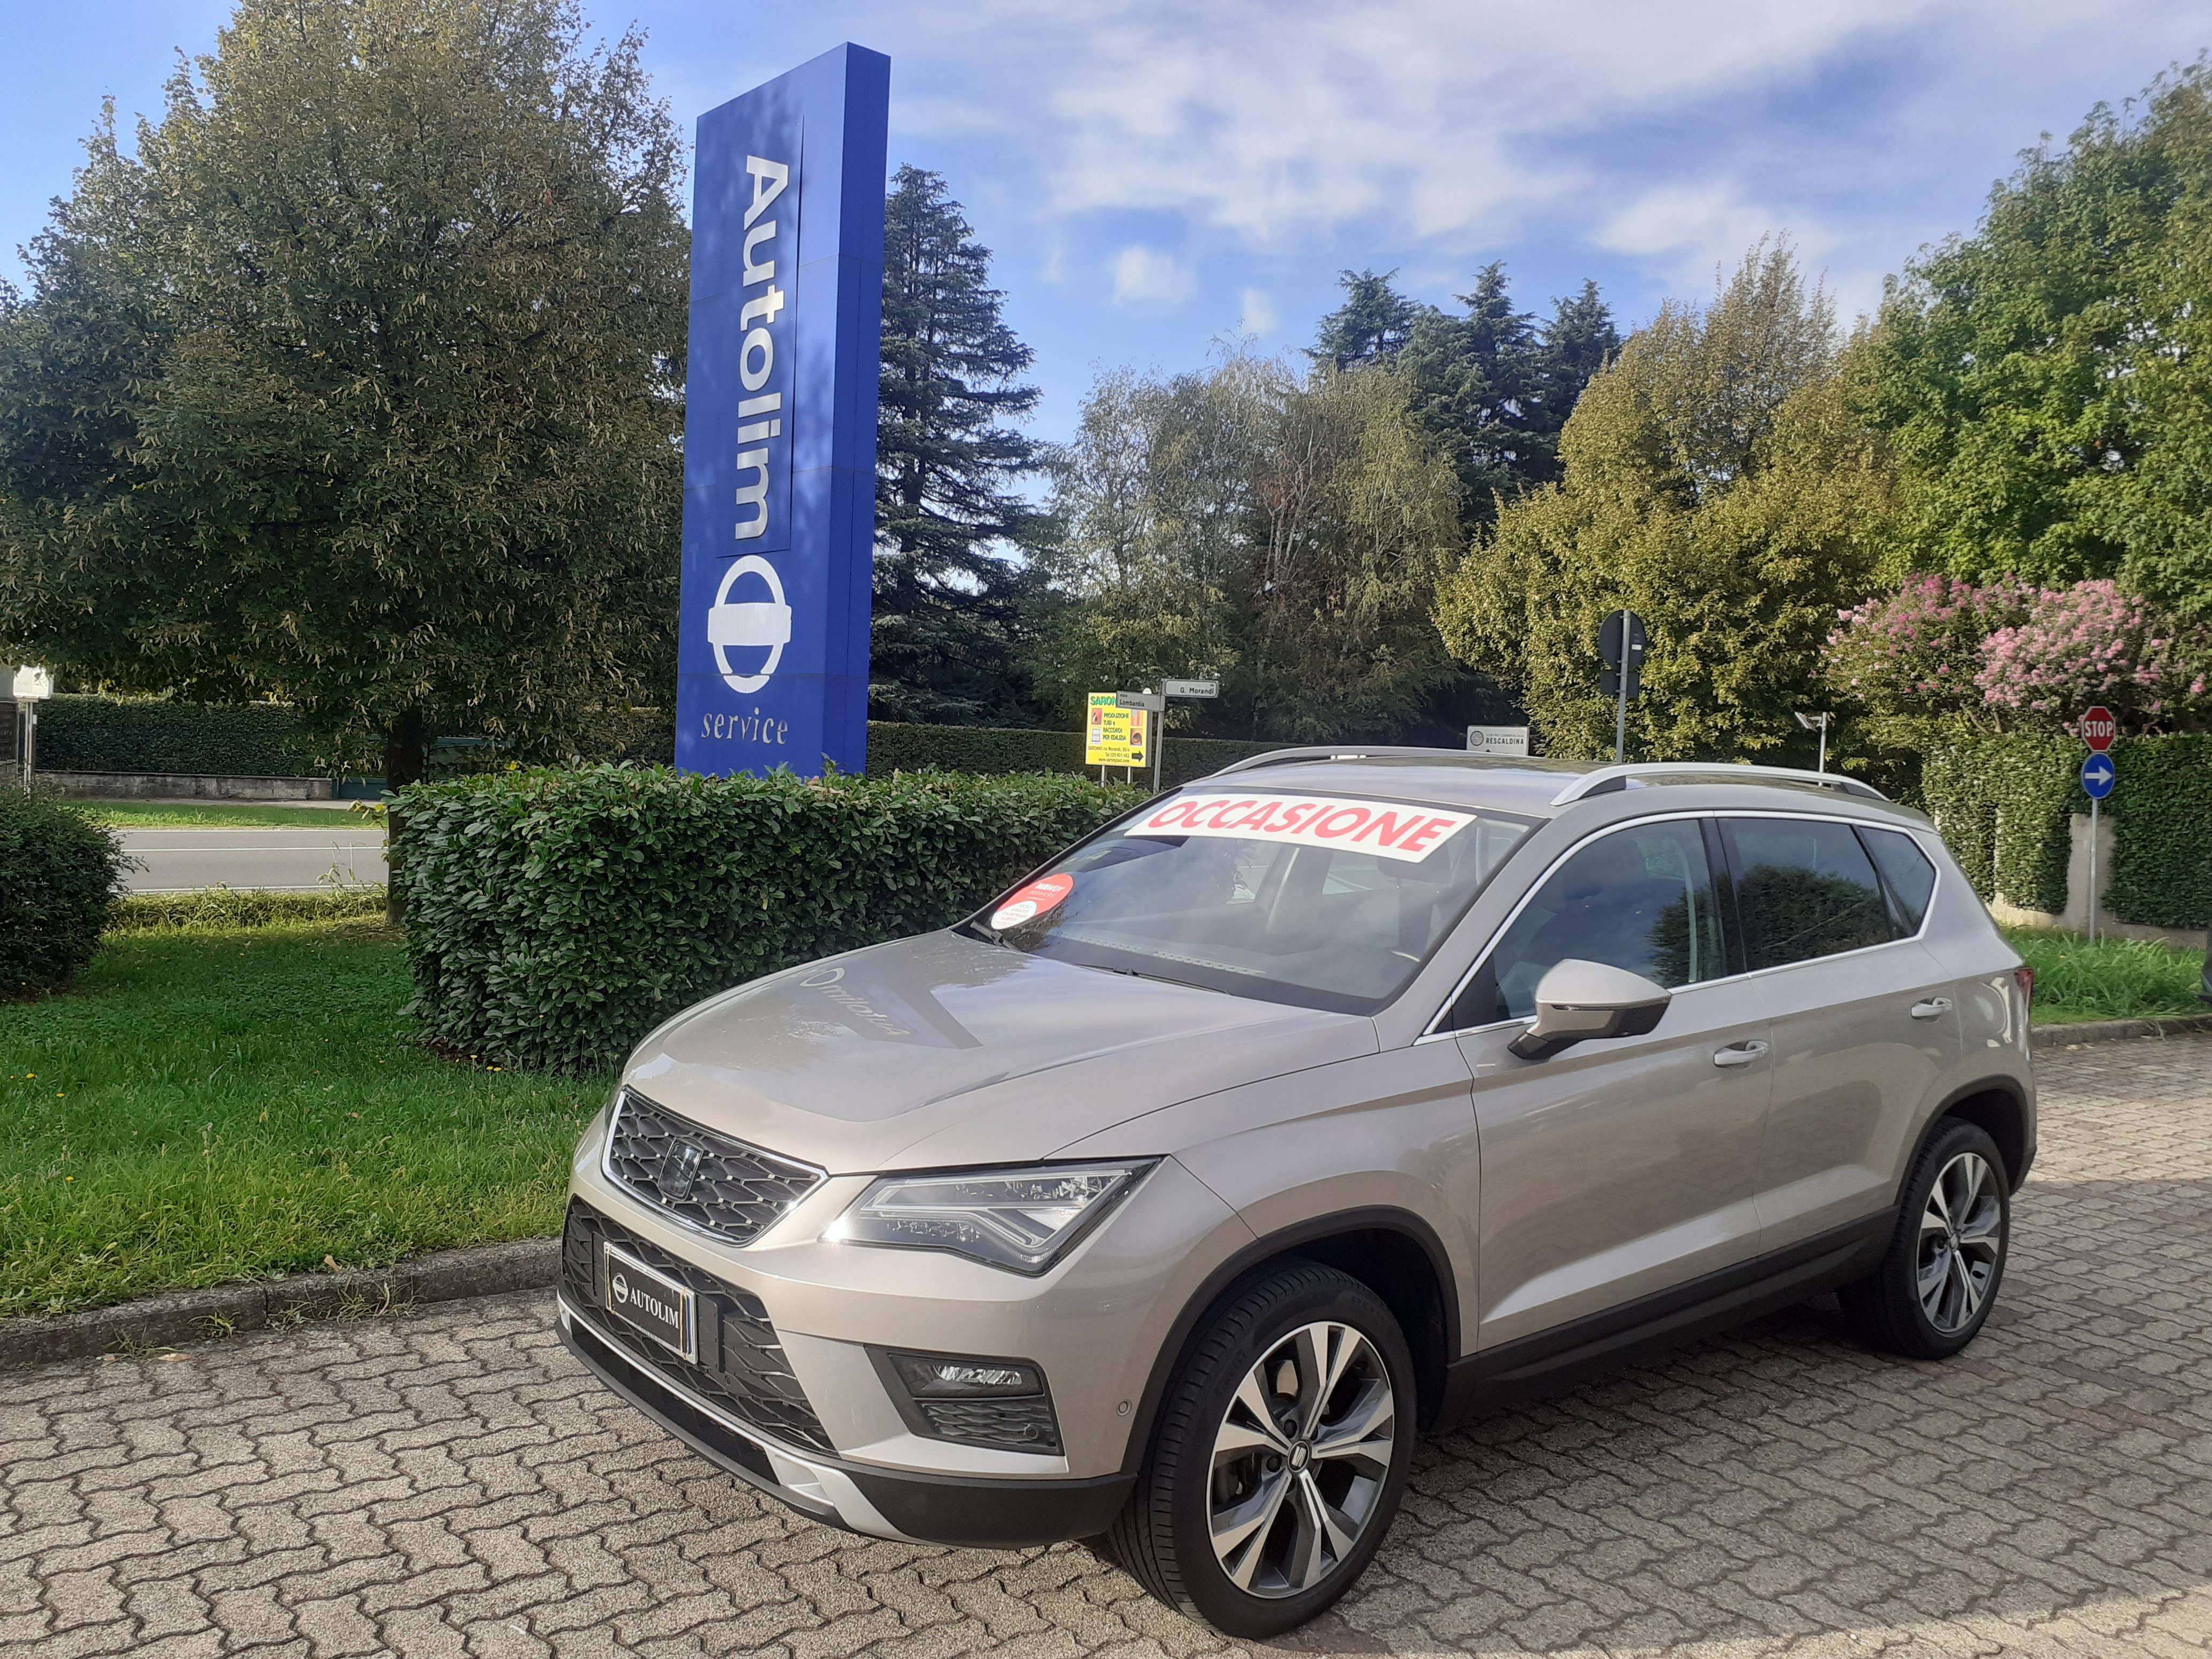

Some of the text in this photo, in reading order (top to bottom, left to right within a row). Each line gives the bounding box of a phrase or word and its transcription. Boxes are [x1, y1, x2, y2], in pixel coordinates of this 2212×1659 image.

[735, 154, 789, 540] Autolim
[1119, 699, 1145, 707] Lombardia
[700, 707, 789, 745] service
[2084, 721, 2113, 737] STOP
[1148, 800, 1458, 852] OCCASIONE
[630, 1287, 679, 1329] AUTOLIM
